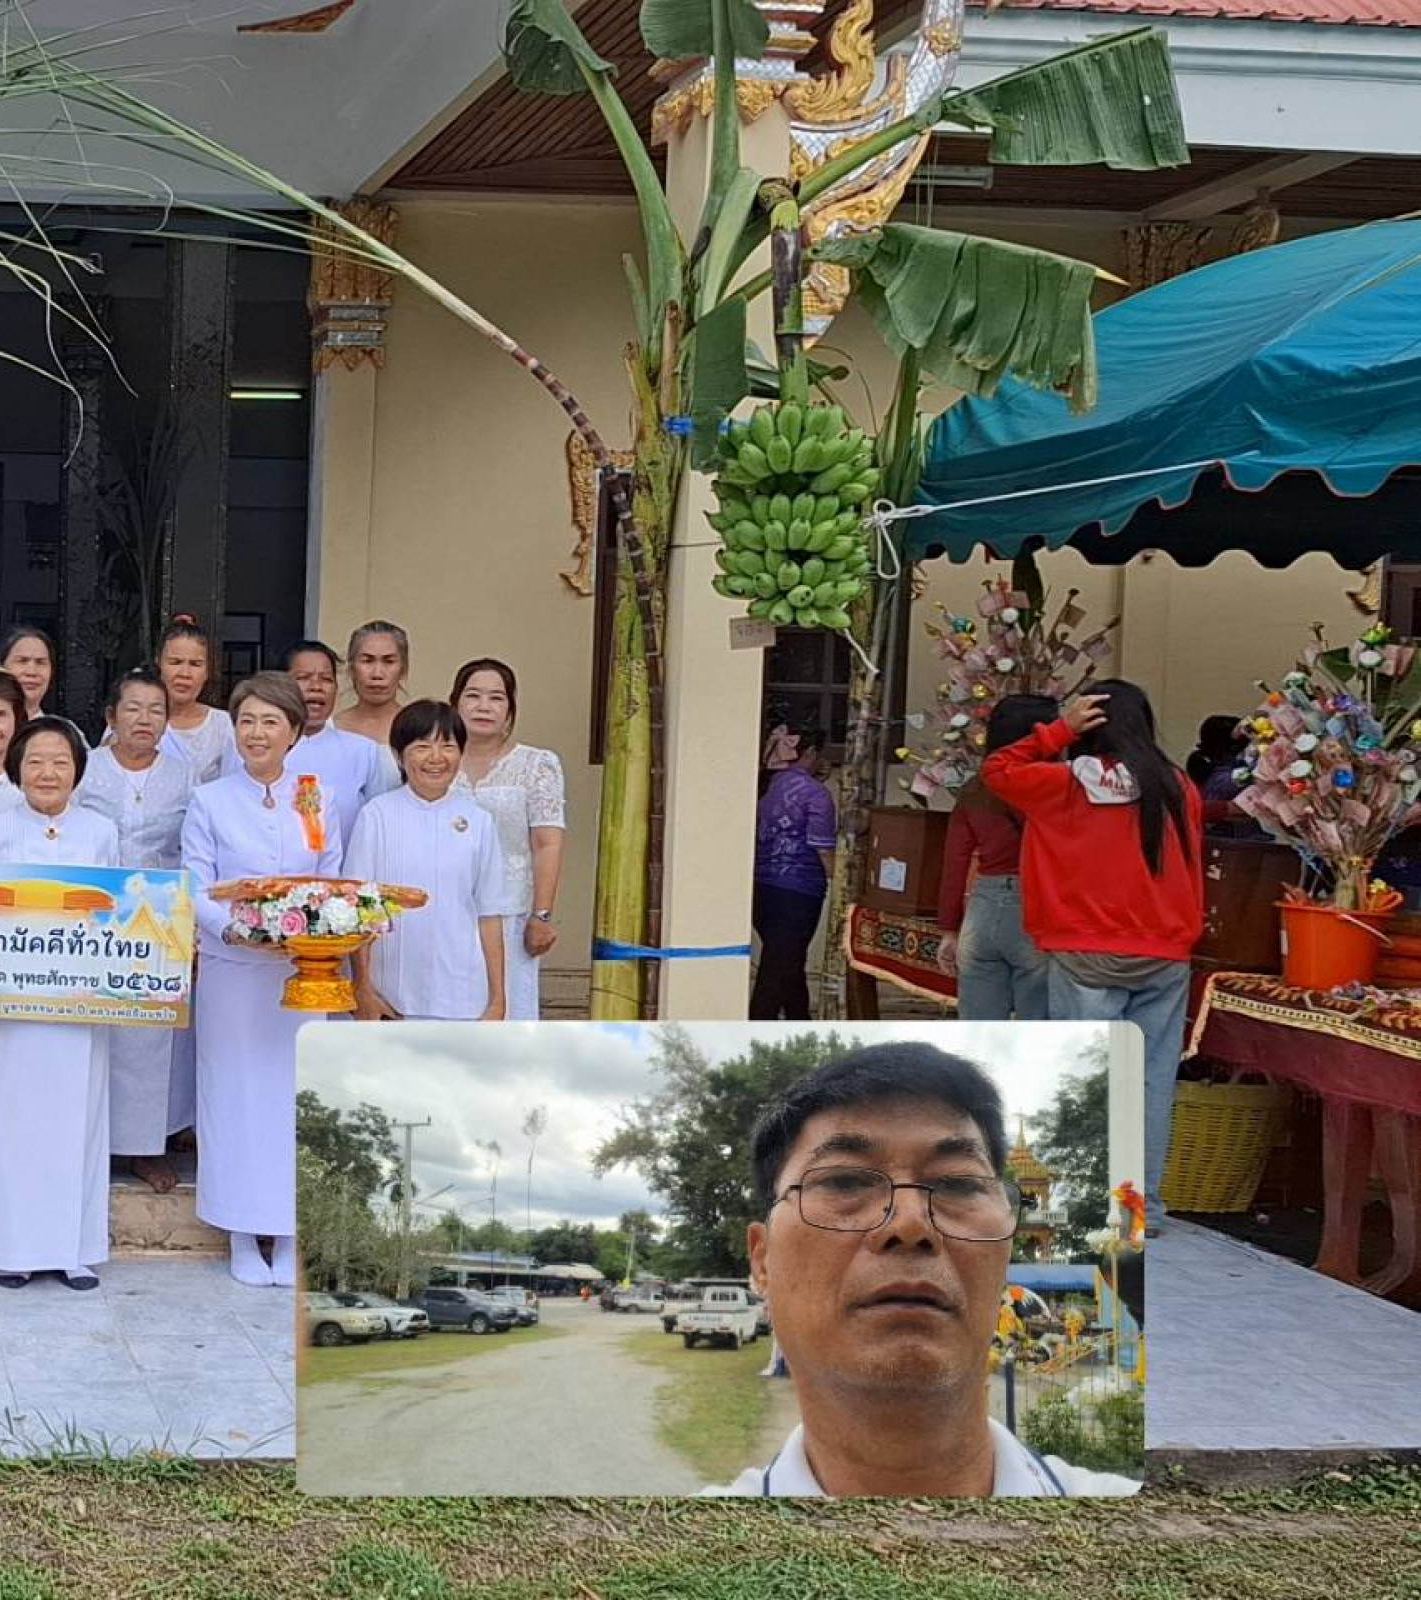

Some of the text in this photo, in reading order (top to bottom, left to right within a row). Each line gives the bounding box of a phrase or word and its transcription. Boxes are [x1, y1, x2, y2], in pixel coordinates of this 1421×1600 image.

[12, 969, 99, 990] พุทธศักราช
[107, 971, 182, 992] ๒๕๖๘
